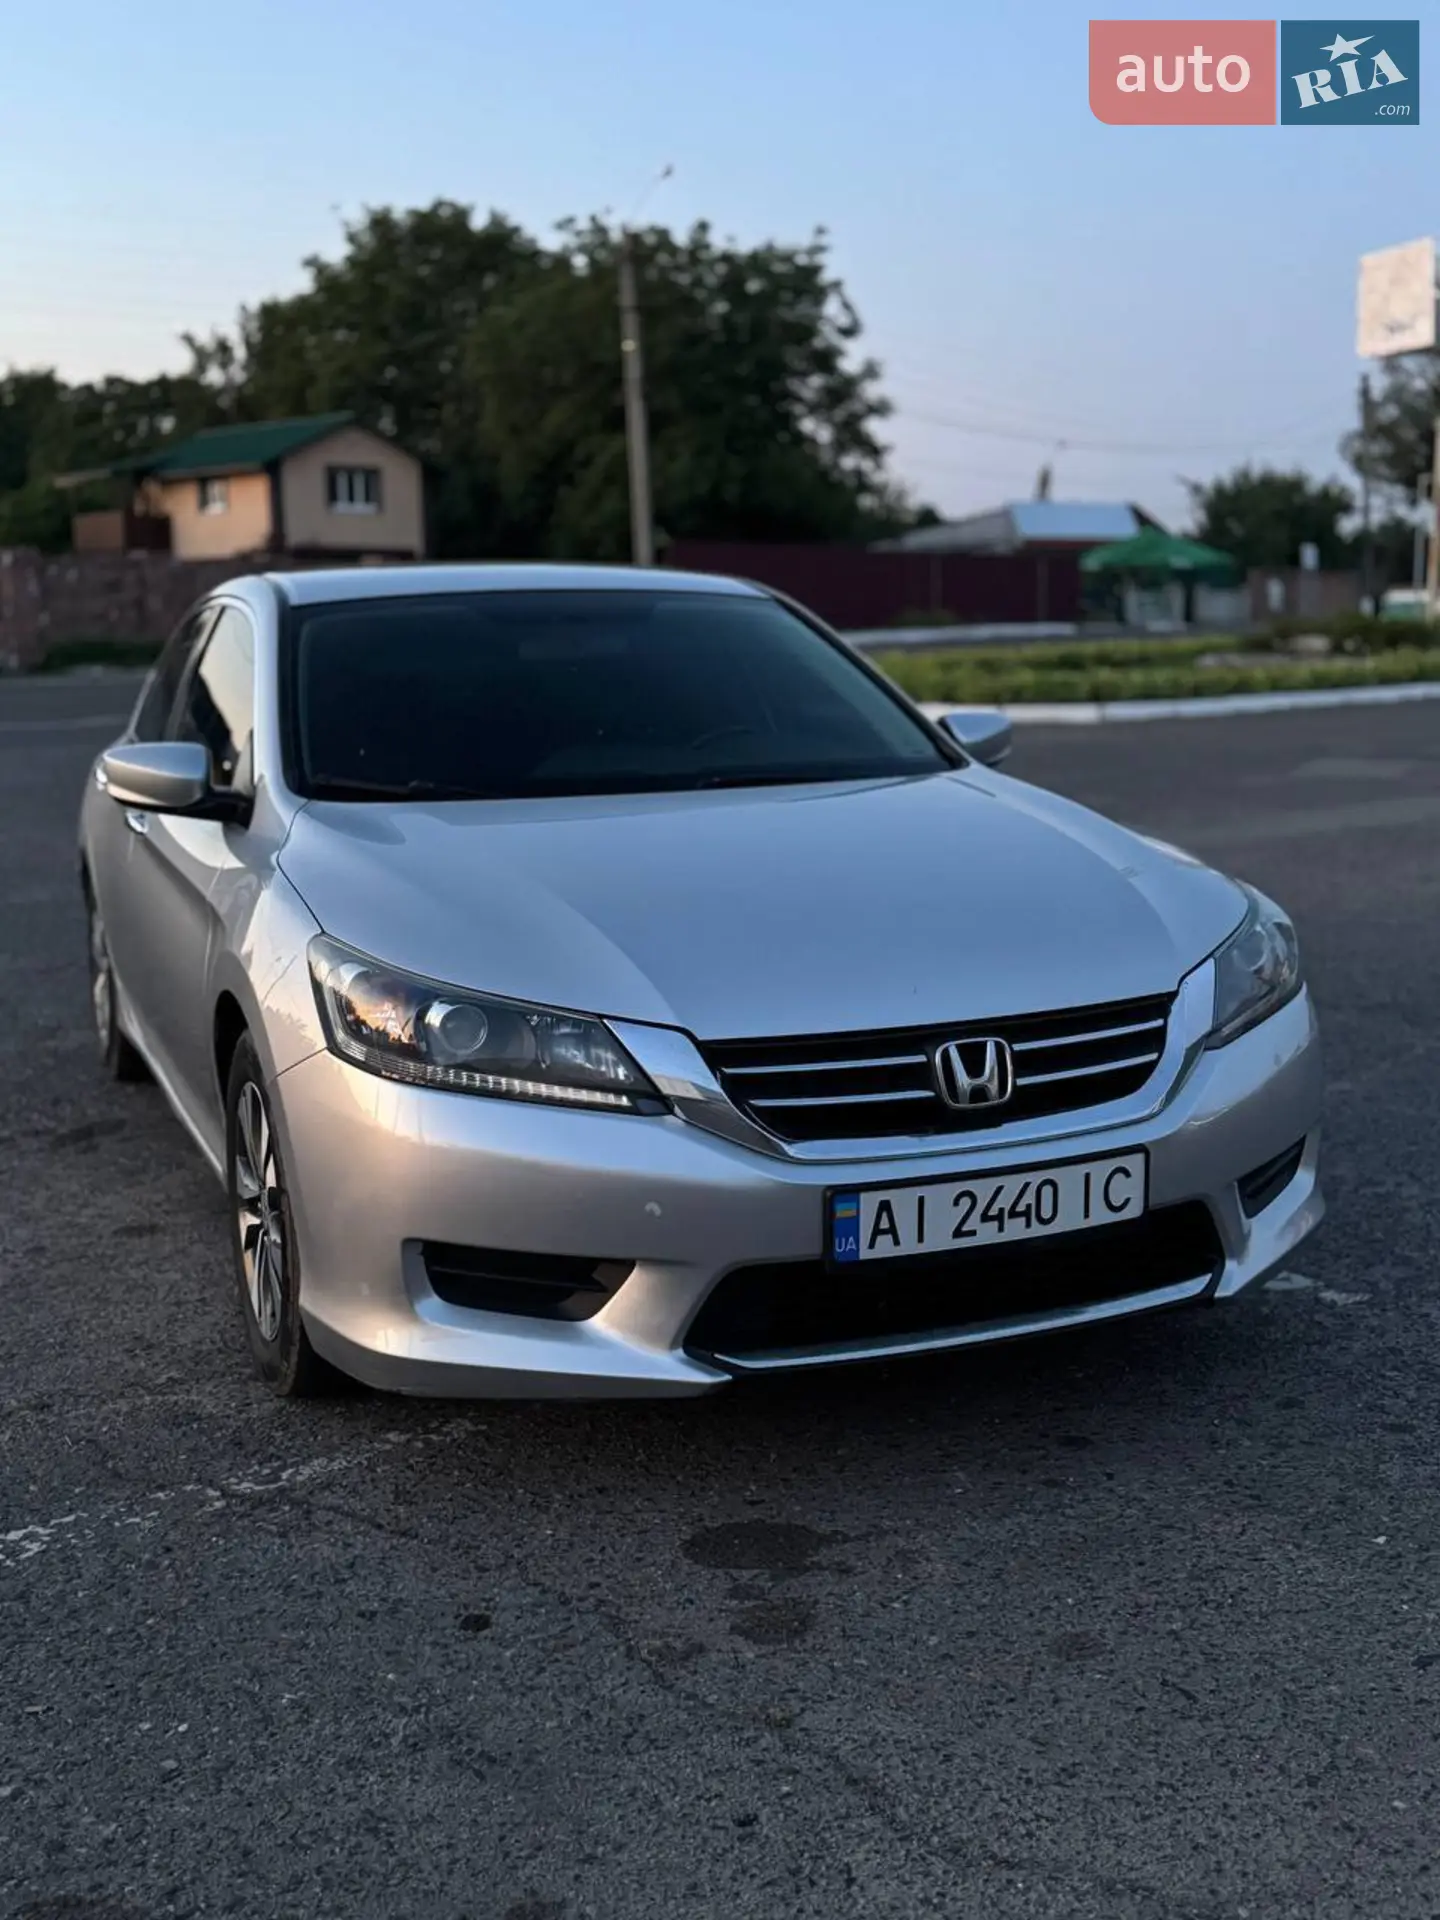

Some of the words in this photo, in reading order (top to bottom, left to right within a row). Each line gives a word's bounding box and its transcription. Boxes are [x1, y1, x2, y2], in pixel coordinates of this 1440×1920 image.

[867, 1194, 925, 1250] AI
[951, 1177, 1059, 1240] 2440
[1083, 1165, 1132, 1220] IC
[834, 1236, 857, 1253] UA
